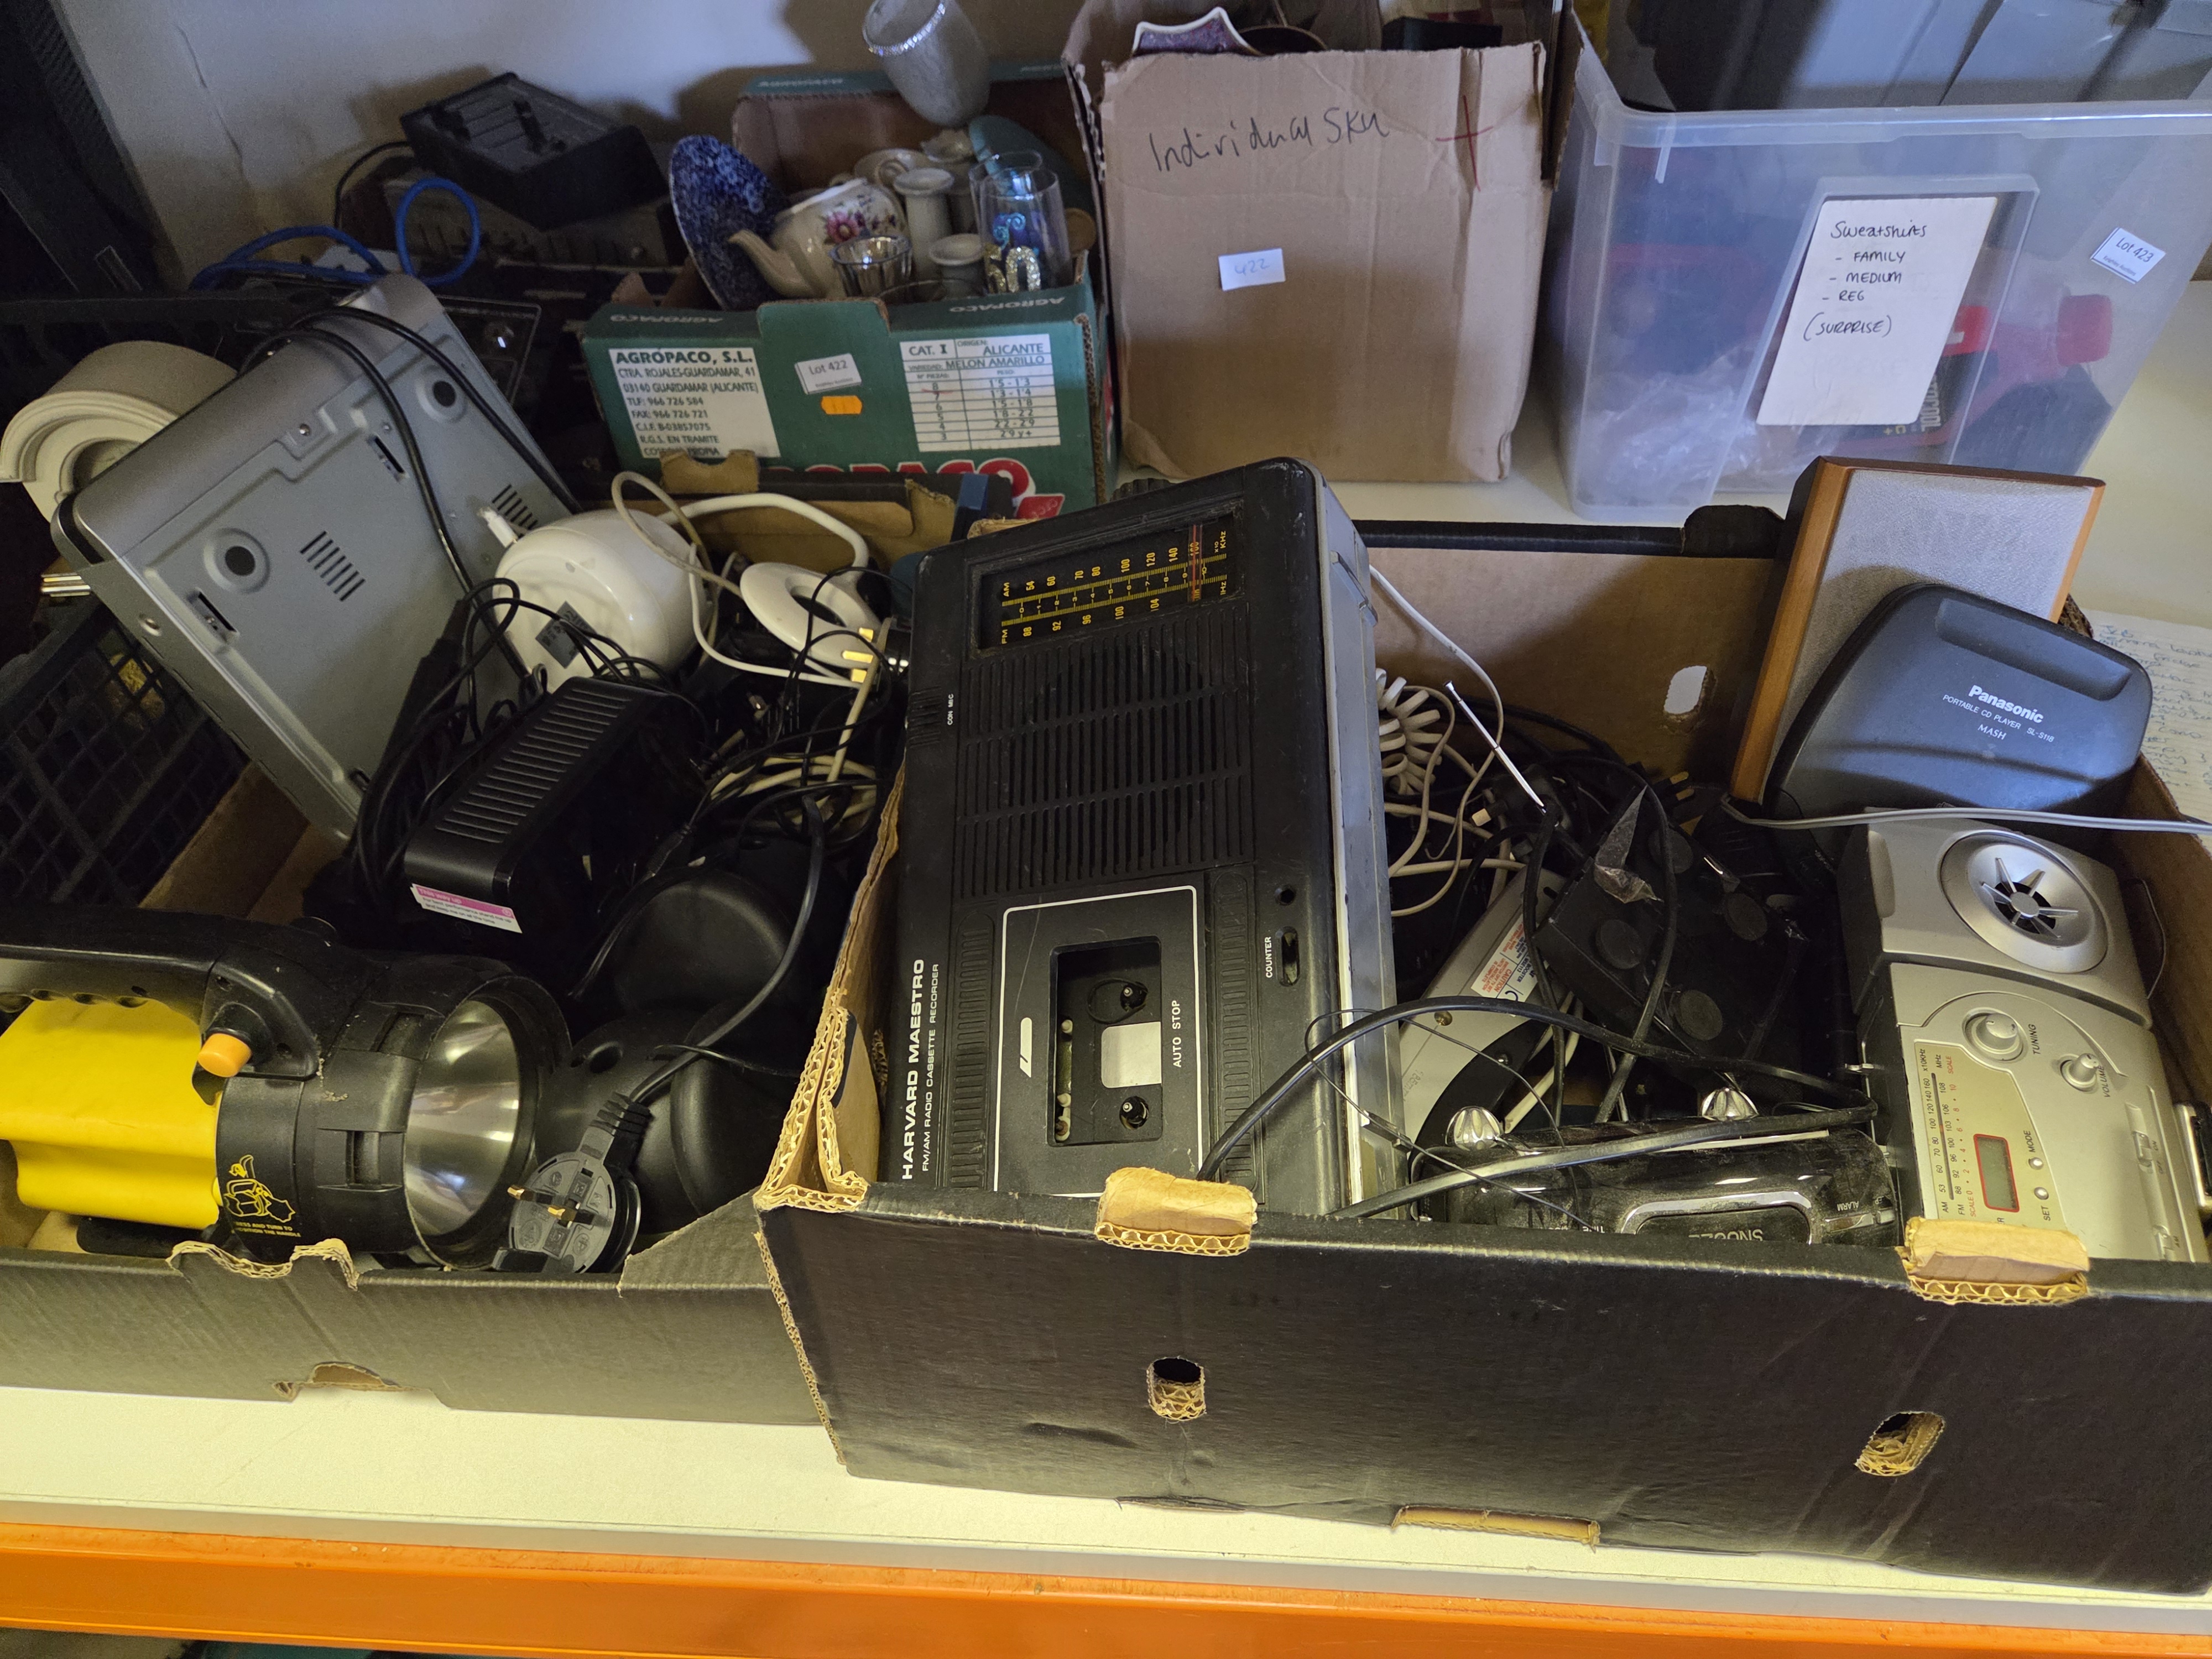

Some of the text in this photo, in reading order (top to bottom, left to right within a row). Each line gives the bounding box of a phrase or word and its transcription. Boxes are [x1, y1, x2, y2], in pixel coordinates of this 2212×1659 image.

[1853, 250, 1906, 265] FAMILY
[2116, 237, 2154, 263] Lot 423
[1234, 258, 1271, 276] 422
[1845, 271, 1902, 284] MEDIUM
[1839, 290, 1865, 302] REG
[909, 343, 948, 356] CAT. I
[983, 342, 1044, 356] ALICANTE
[616, 351, 753, 365] AGROPACO, S.L.
[946, 359, 986, 370] MELON
[989, 355, 1045, 367] AMARILLO
[808, 359, 848, 375] Lot 422
[932, 382, 939, 391] 8
[1003, 582, 1010, 597] AM
[1026, 581, 1035, 591] 54
[1047, 576, 1056, 587] 60
[1092, 566, 1100, 577] 80
[1121, 558, 1130, 573] 100
[1146, 552, 1155, 567] 120
[1168, 547, 1178, 562] 140
[1001, 629, 1008, 644] FM
[1023, 626, 1032, 637] 88
[1052, 620, 1061, 631] 92
[1082, 614, 1092, 625] 96
[1115, 606, 1124, 620] 100
[1942, 694, 1980, 713] PORTABLE
[1981, 709, 1992, 718] CD
[1993, 714, 2021, 729] PLAYER
[1968, 685, 2044, 723] Panasonic
[1978, 724, 2007, 740] MASH
[1264, 936, 1274, 979] COUNTER
[1494, 968, 1512, 993] CAUTION
[1517, 964, 1531, 983] BOOSTER
[1171, 998, 1183, 1068] AUTO STOP
[2028, 1023, 2041, 1056] TUNING
[902, 958, 925, 1181] HARVARD MAESTRO
[922, 963, 939, 1172] FM/AM RADIO CASSETTE RECORDER
[1945, 1055, 1954, 1074] SCALE
[2098, 1065, 2111, 1098] VOLUME
[1932, 1136, 1939, 1145] 80
[1947, 1137, 1955, 1149] 100
[2023, 1129, 2037, 1153] MODE
[1933, 1148, 1941, 1157] 70
[1950, 1154, 1958, 1162] 96
[1936, 1165, 1943, 1173] 60
[1953, 1170, 1960, 1178] 92
[1938, 1183, 1946, 1193] 53
[1955, 1186, 1962, 1195] 88
[1837, 1201, 1859, 1212] ALARM
[1940, 1201, 1949, 1213] AM
[1958, 1204, 1965, 1215] FM
[1968, 1196, 1976, 1217] SCALE
[2041, 1205, 2052, 1222] SET
